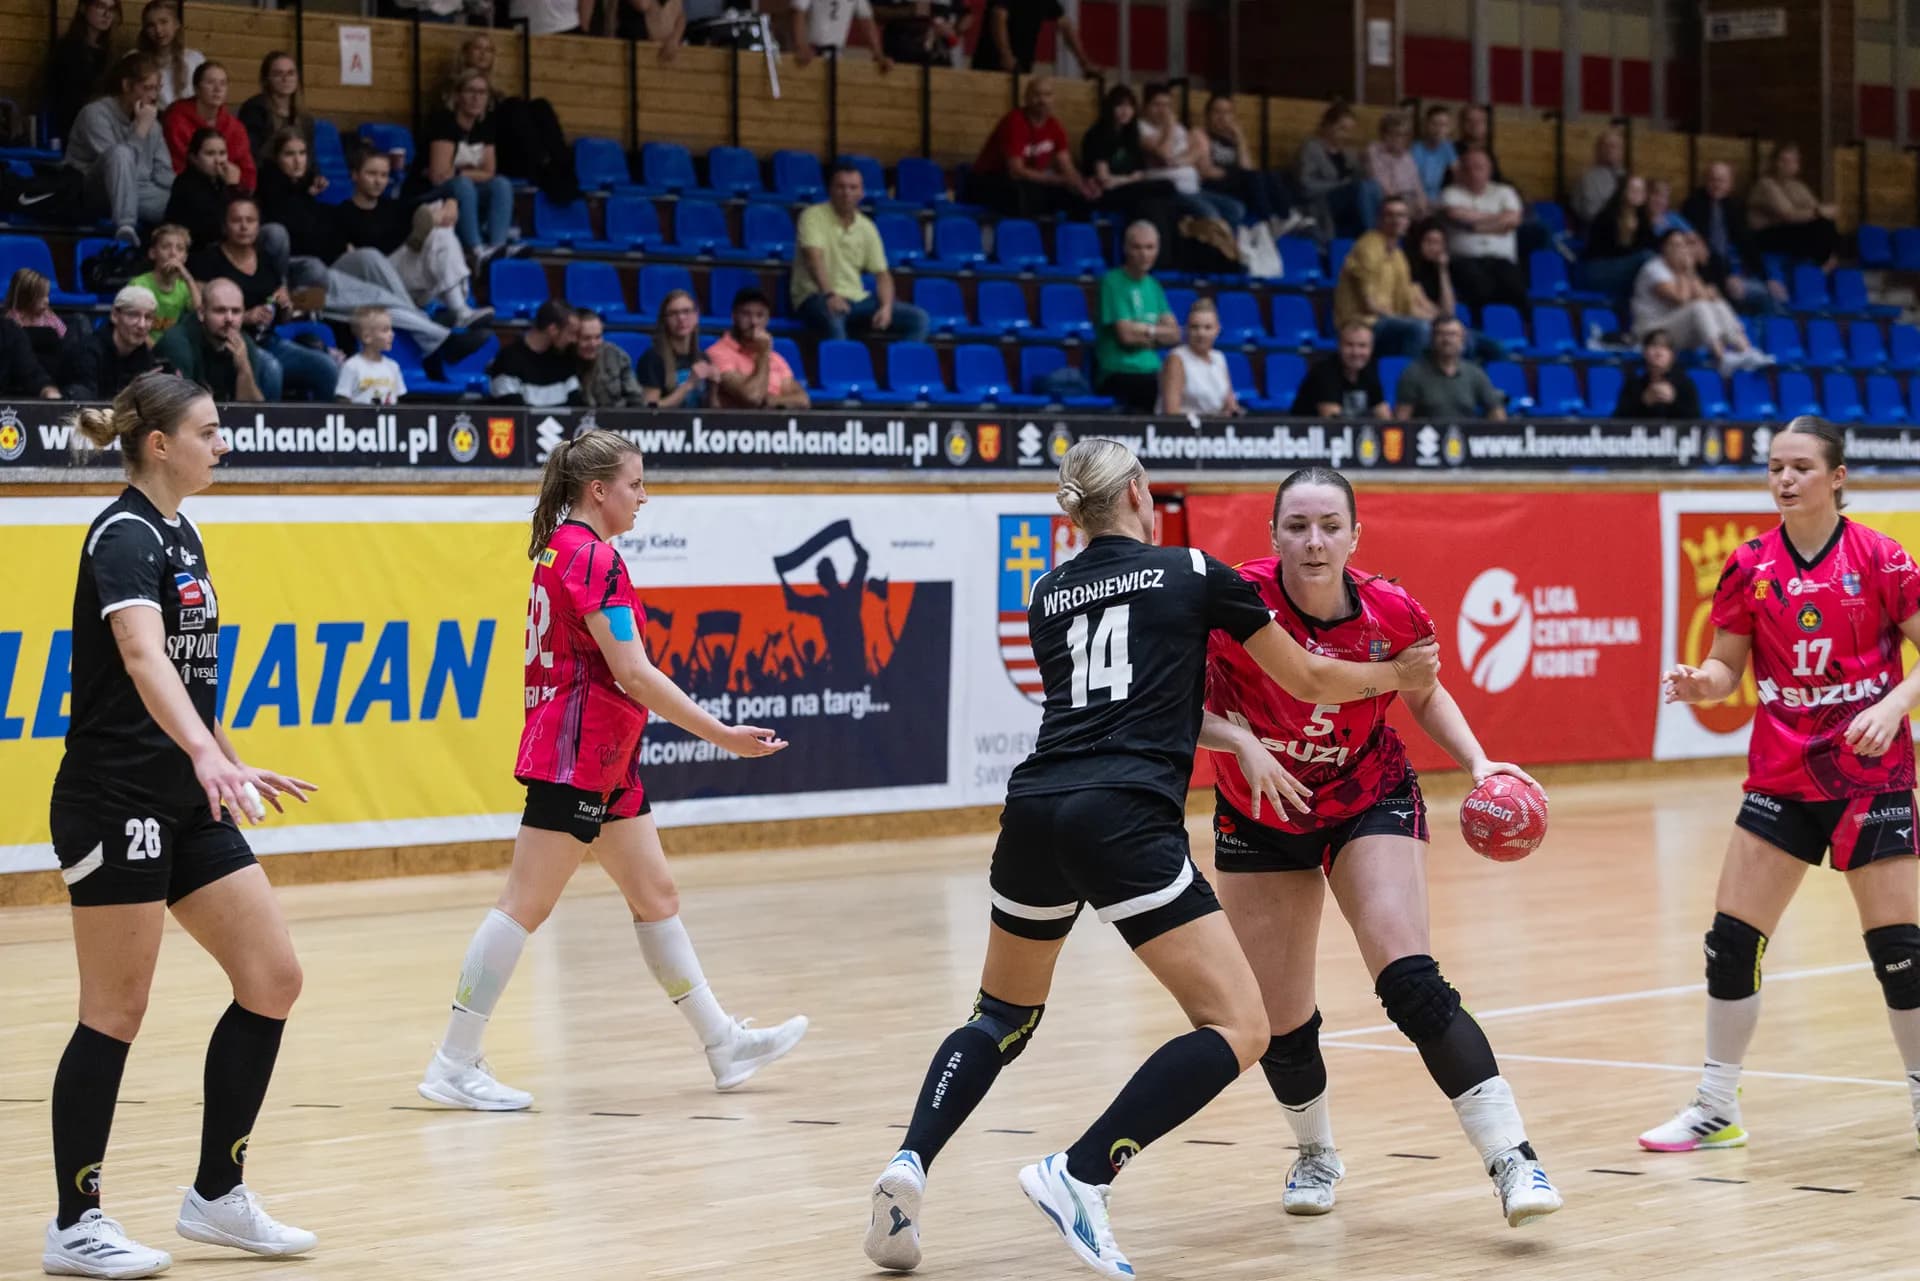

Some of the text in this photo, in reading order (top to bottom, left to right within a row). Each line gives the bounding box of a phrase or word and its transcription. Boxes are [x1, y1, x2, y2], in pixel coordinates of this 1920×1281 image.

[1043, 568, 1165, 617] WRONIEWICZ
[1533, 586, 1578, 614] LIGA
[1532, 616, 1642, 647] CENTRALNA
[1066, 604, 1133, 708] 14
[1531, 648, 1600, 678] KOBIET
[1792, 638, 1832, 676] 17
[737, 692, 787, 723] pora
[792, 693, 819, 717] na
[824, 685, 890, 719] targi...
[1303, 704, 1341, 736] 5
[578, 800, 602, 817] Targi
[1466, 798, 1513, 823] molten
[1749, 792, 1782, 813] Kielce
[125, 817, 162, 860] 28
